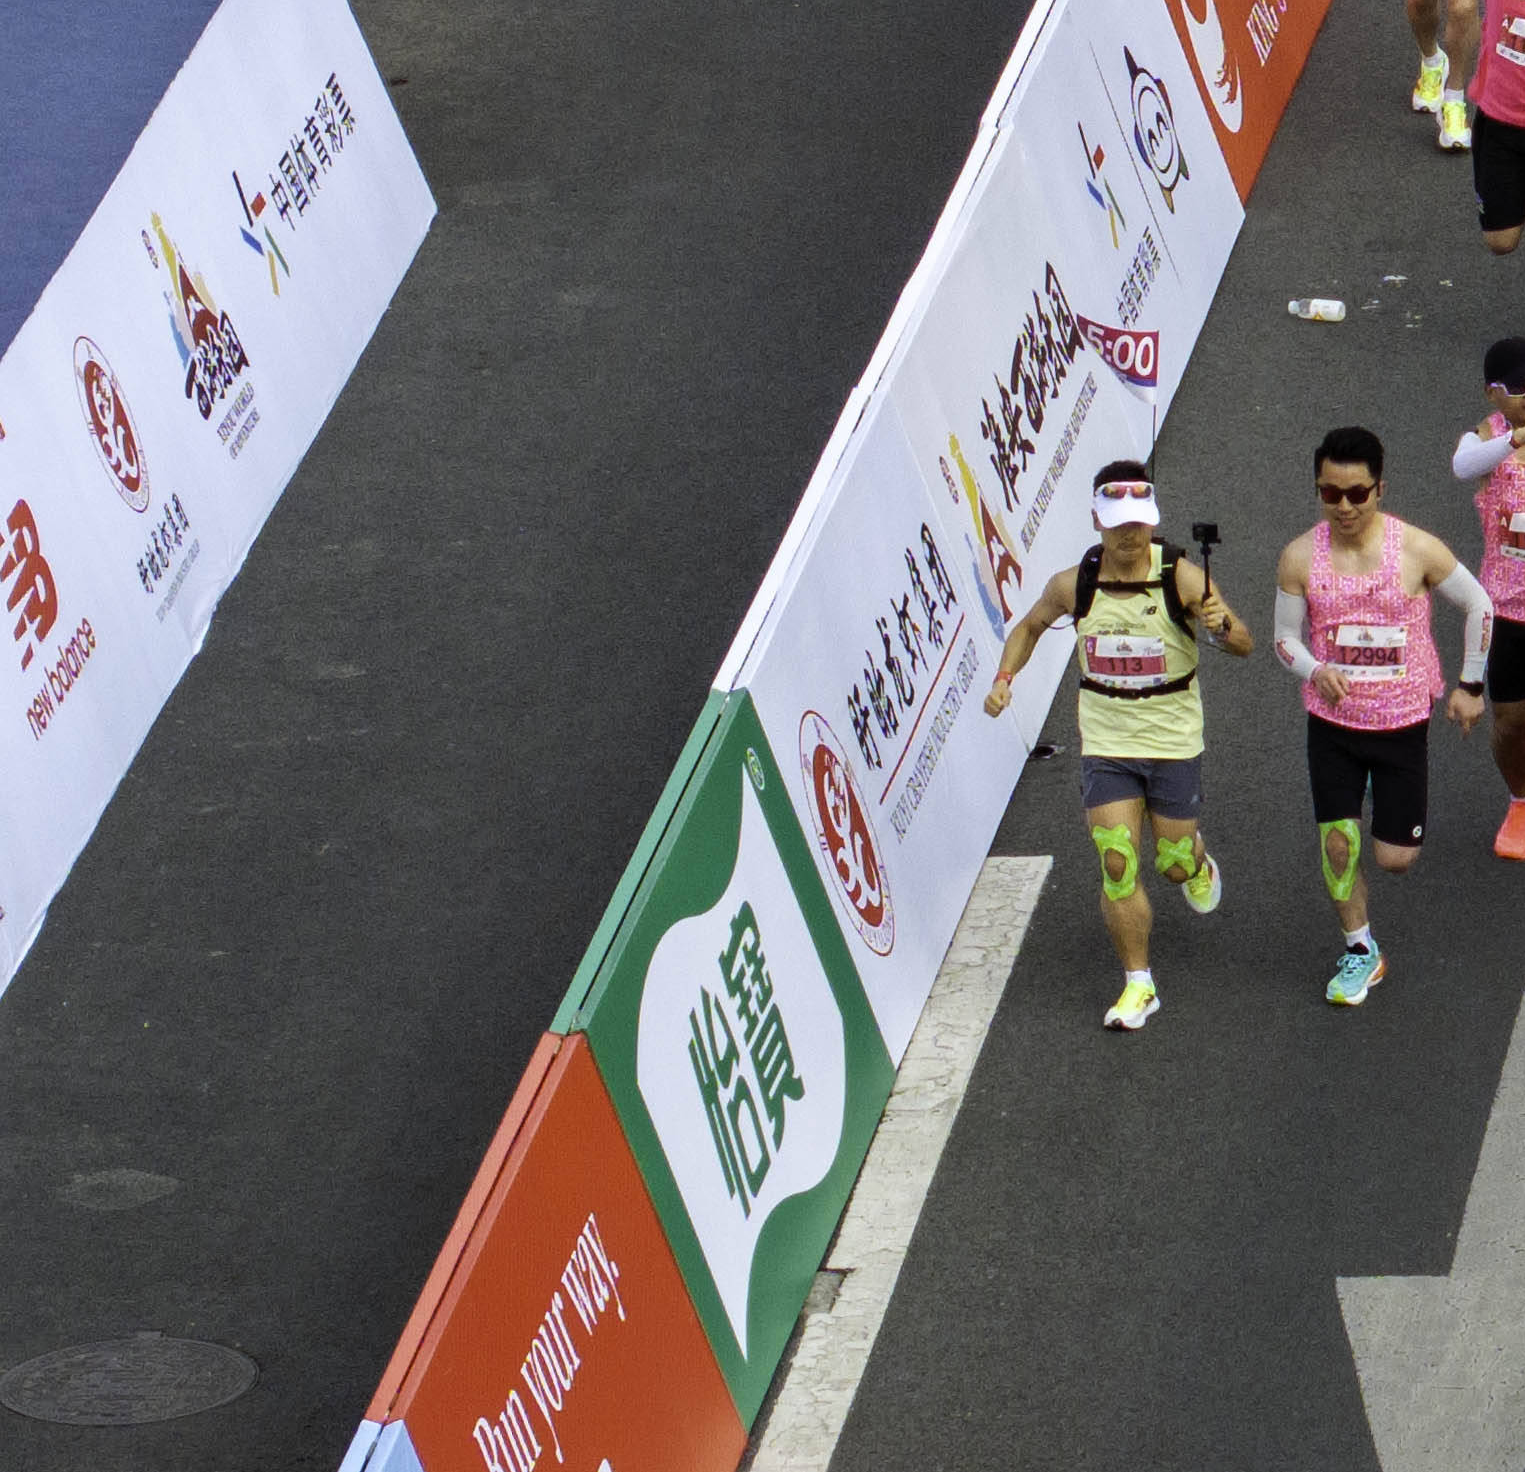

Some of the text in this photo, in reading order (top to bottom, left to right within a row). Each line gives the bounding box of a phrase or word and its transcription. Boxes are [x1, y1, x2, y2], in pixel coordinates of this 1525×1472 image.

[269, 71, 357, 232] 中国体育彩票
[981, 260, 1086, 514] 淮安西游乐园
[1086, 325, 1154, 376] 5:00
[25, 616, 97, 742] new balance
[847, 521, 958, 771] 盱眙龙虾集团
[1107, 657, 1143, 674] 113
[1338, 646, 1398, 667] 12994
[521, 1306, 582, 1449] your
